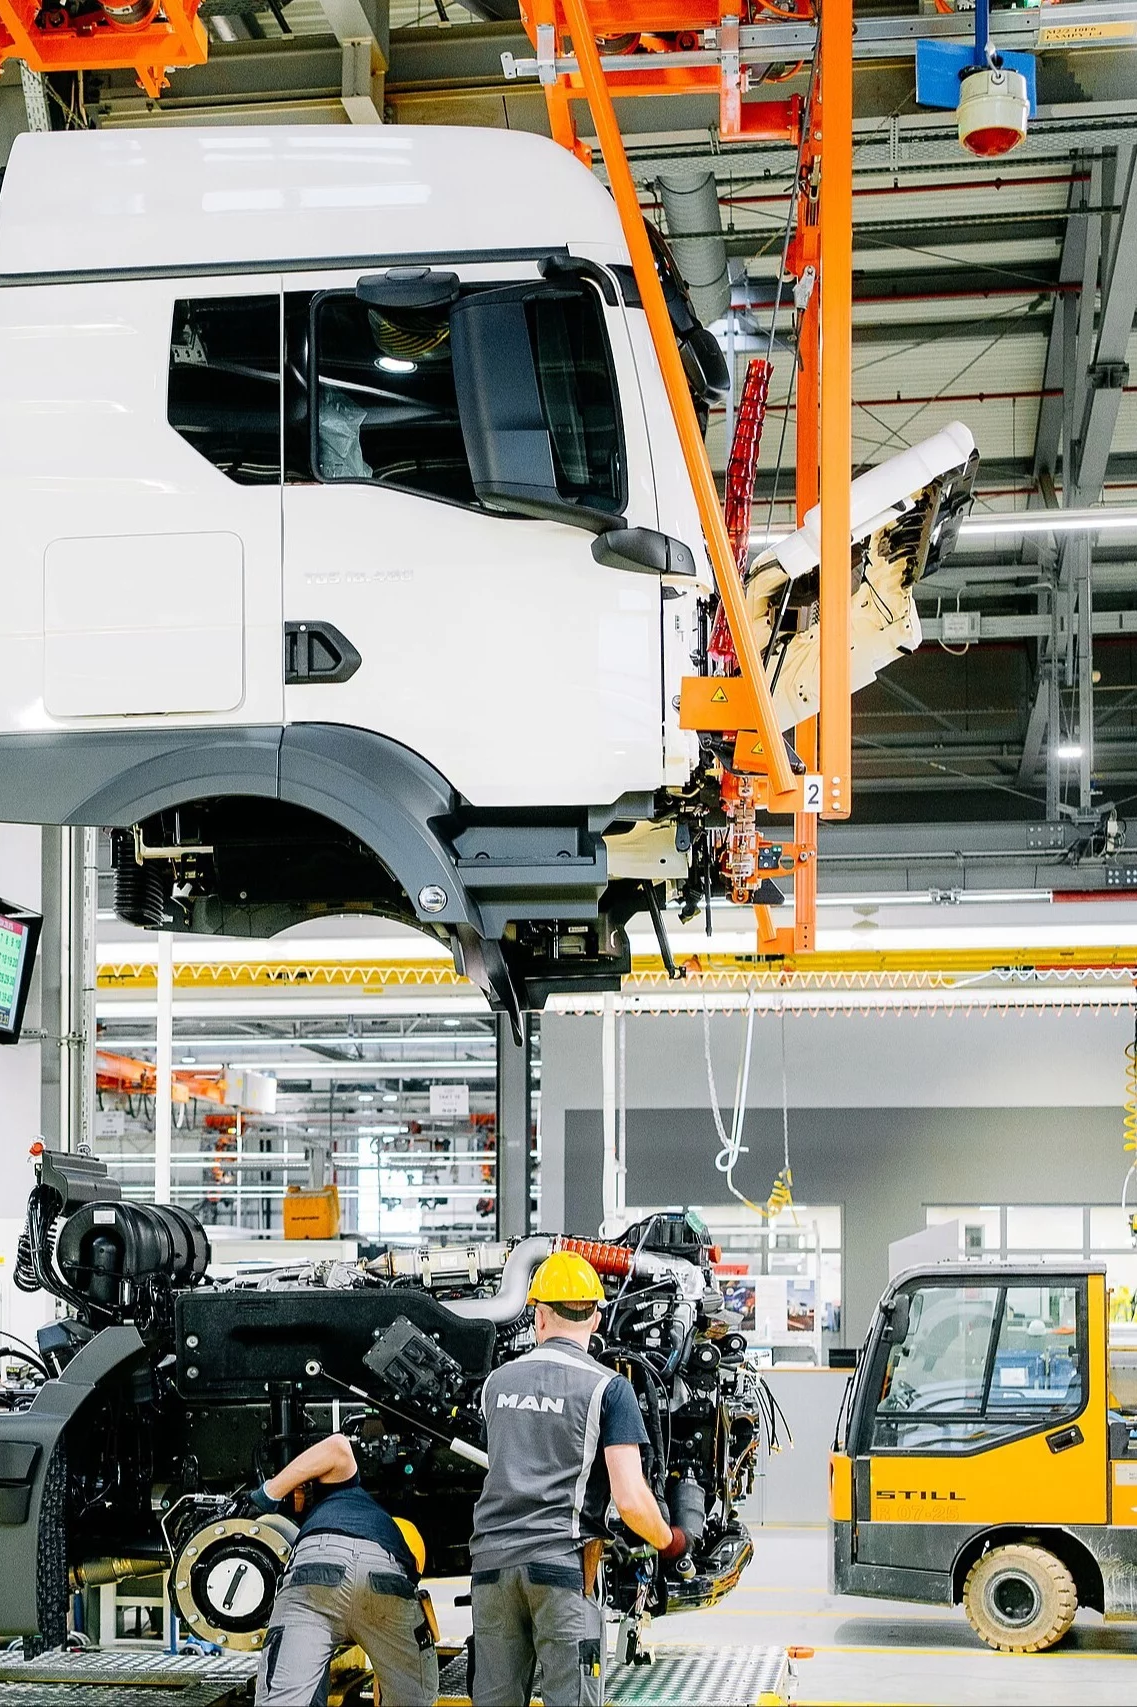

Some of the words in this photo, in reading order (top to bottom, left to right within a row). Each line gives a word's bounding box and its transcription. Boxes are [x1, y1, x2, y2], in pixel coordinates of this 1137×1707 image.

[808, 783, 819, 805] 2
[496, 1393, 565, 1414] MAN
[876, 1490, 967, 1501] STILL
